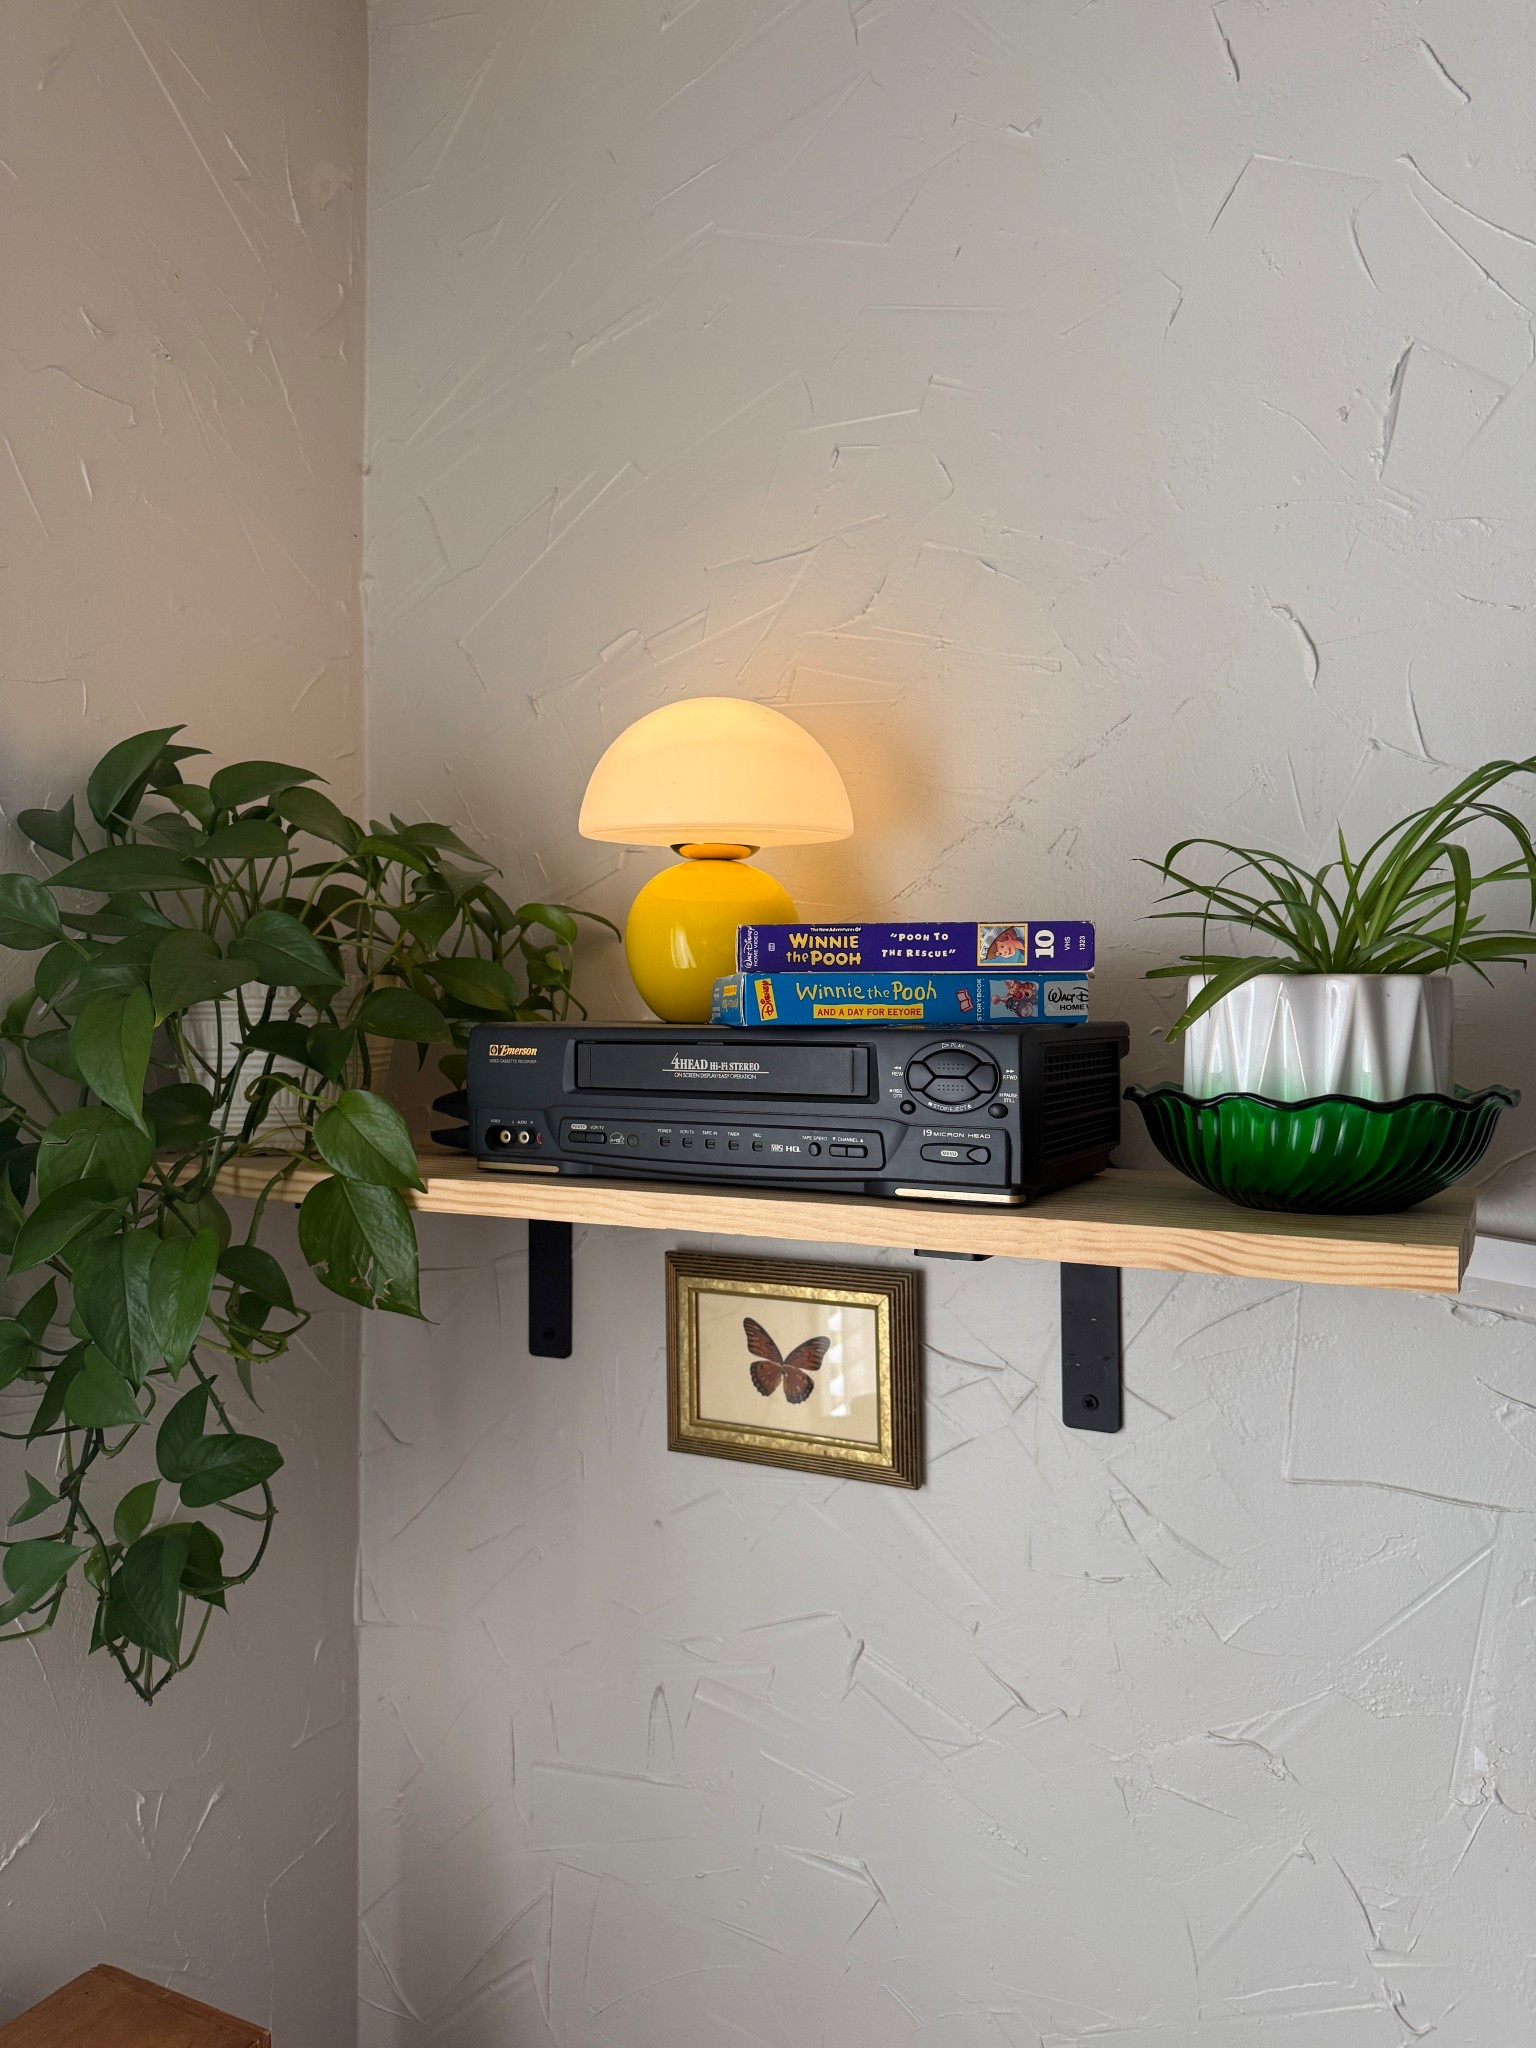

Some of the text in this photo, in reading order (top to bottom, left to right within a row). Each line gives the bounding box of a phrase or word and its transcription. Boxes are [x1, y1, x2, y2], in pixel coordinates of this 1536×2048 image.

[934, 932, 949, 941] TO
[1035, 929, 1055, 959] 10
[786, 951, 809, 962] the
[881, 949, 902, 958] THE
[796, 980, 937, 1000] Winnie the Pooh
[817, 1008, 922, 1016] AND A DAY FOR EEYORE
[499, 1045, 538, 1056] Emerson
[710, 1062, 728, 1070] Hi-Fi
[729, 1062, 760, 1071] STEREO
